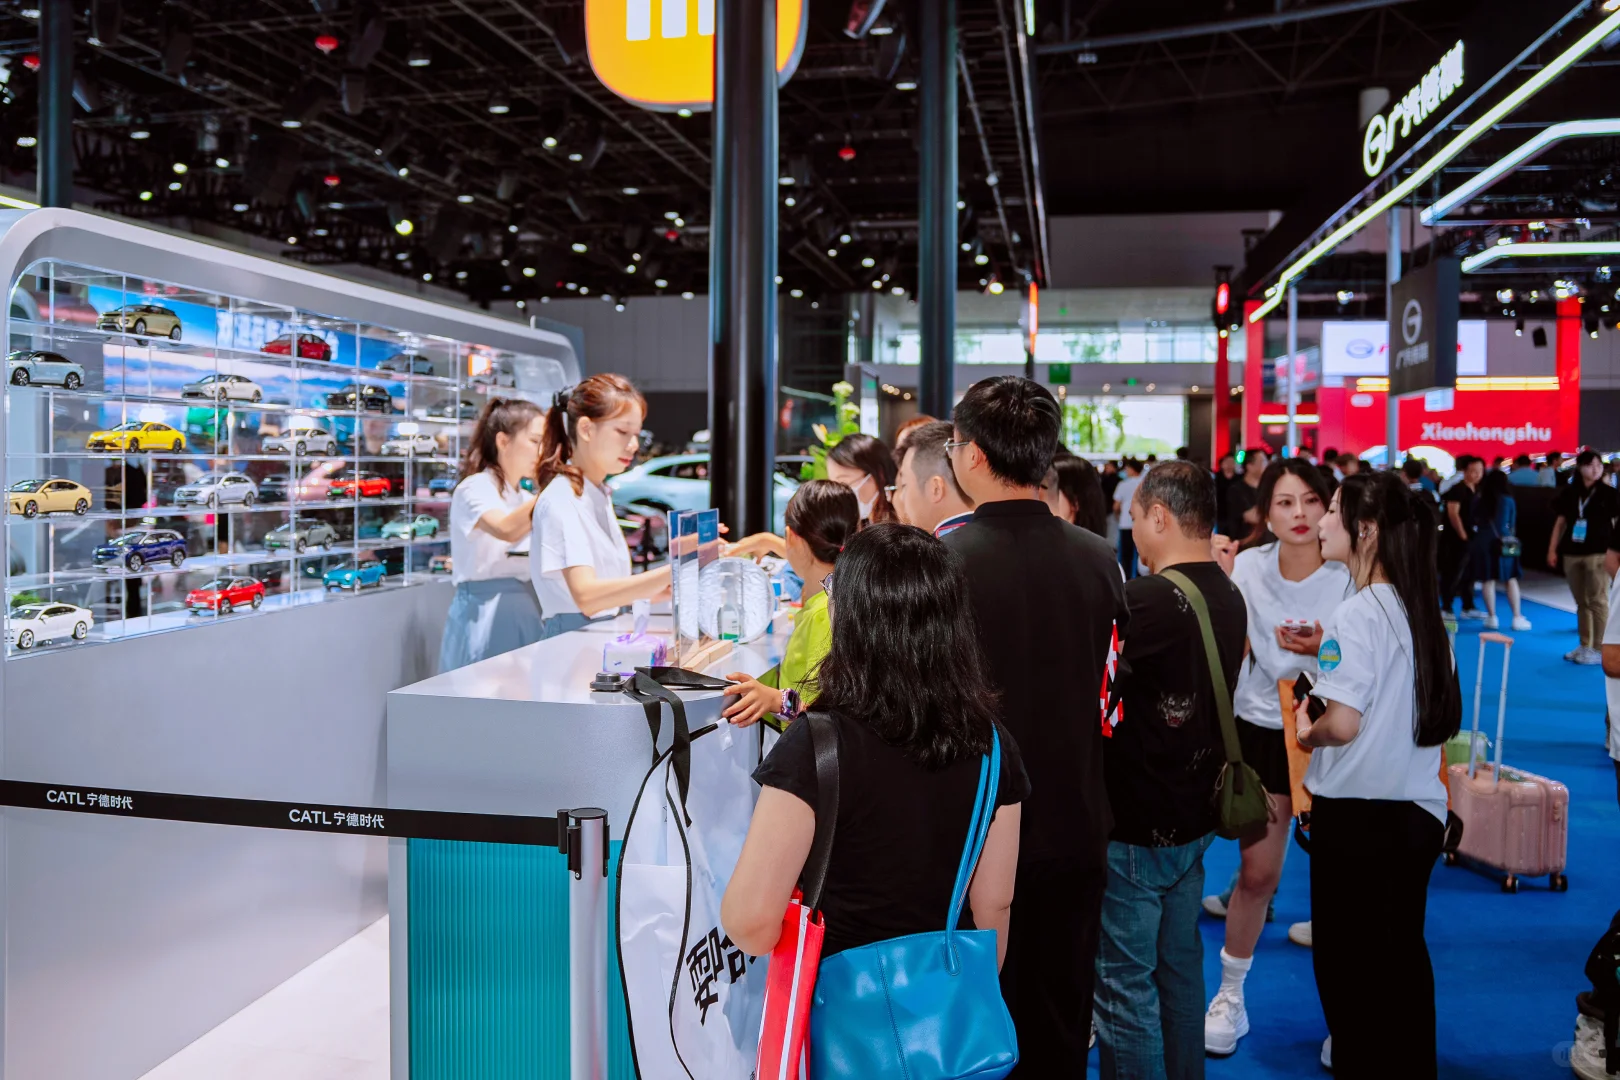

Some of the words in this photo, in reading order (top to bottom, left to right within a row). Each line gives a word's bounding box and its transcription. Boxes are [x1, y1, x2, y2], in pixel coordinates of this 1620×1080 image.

[1421, 421, 1552, 446] Xiaohongshu
[46, 789, 86, 806] CATL
[86, 792, 134, 810] 宁德时代
[288, 808, 332, 825] CATL
[333, 811, 385, 829] 宁德时代
